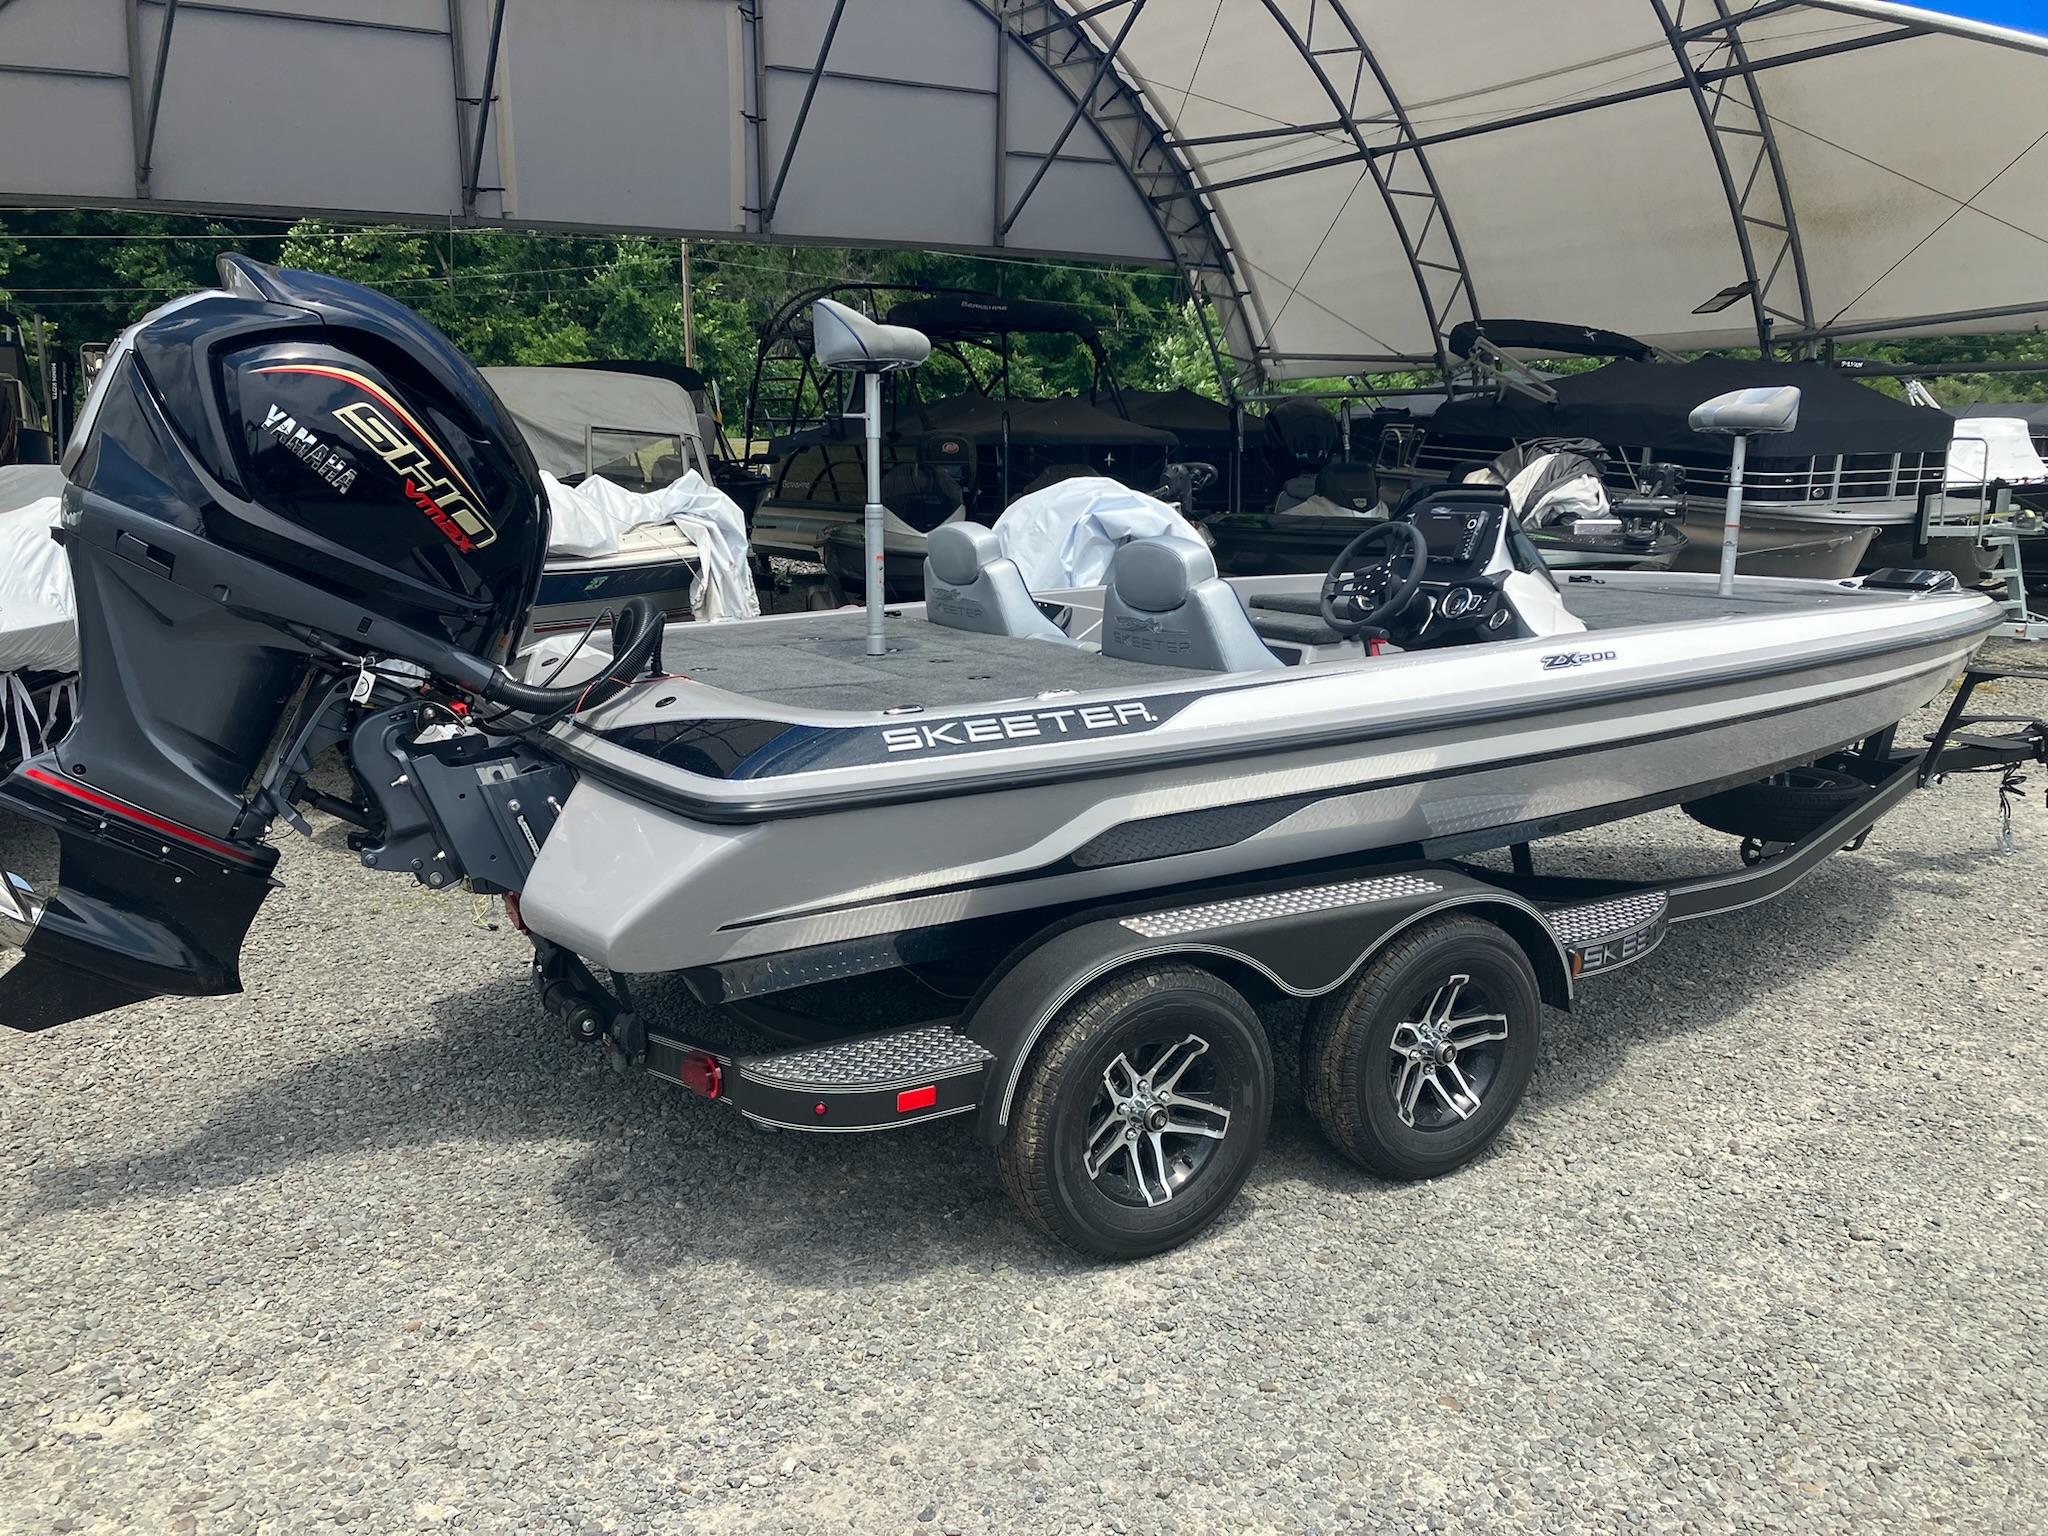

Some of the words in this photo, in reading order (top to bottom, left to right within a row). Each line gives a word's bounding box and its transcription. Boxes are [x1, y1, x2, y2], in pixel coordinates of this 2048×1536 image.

[261, 403, 358, 495] YAMAHA
[332, 401, 497, 549] SHO
[1113, 631, 1192, 654] SKEETER
[1540, 651, 1617, 671] ZX200
